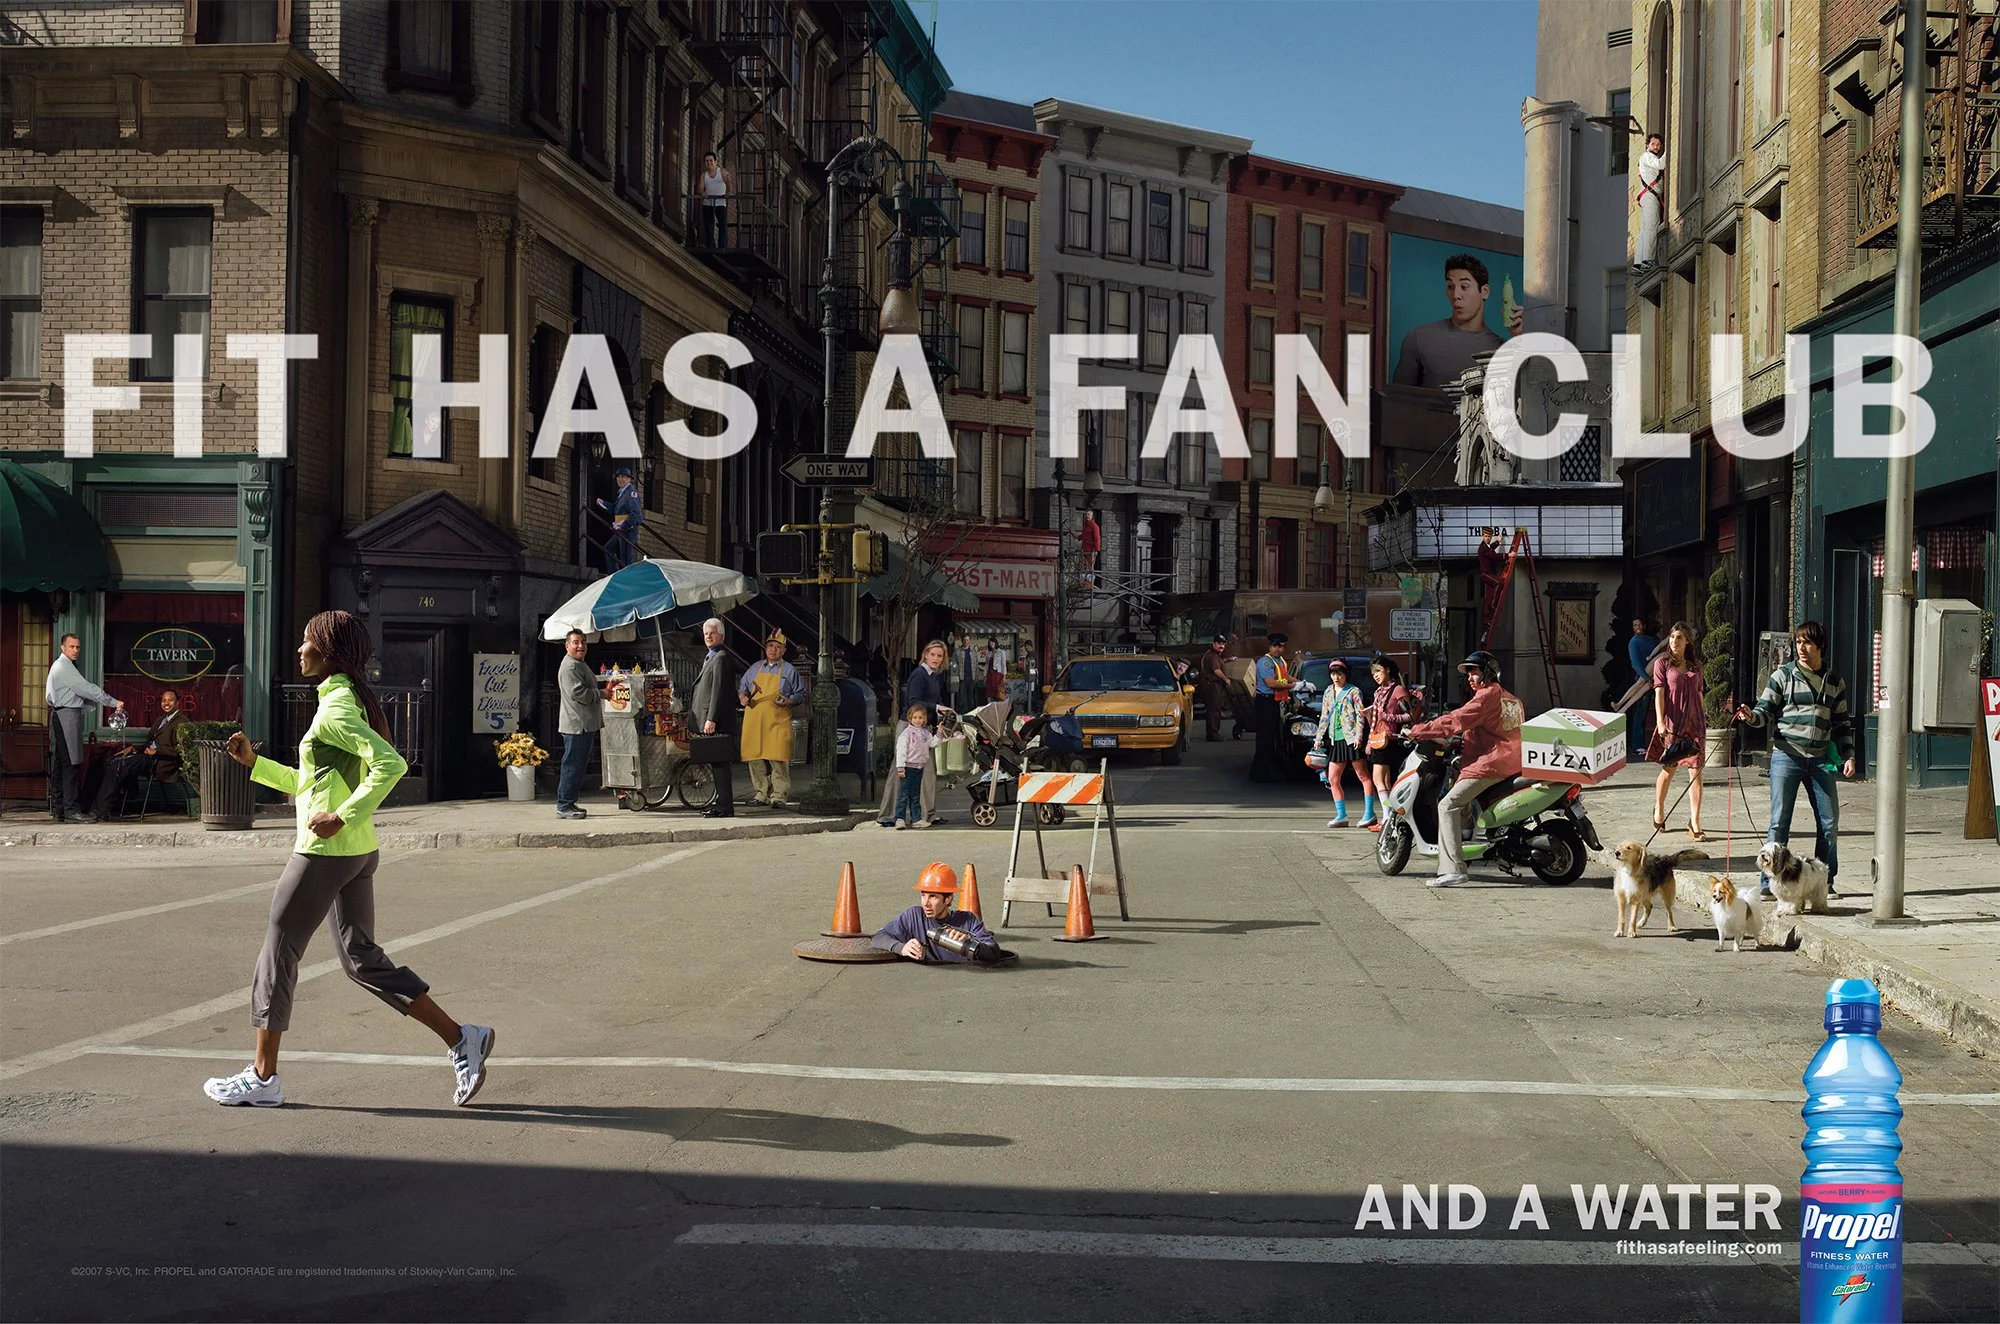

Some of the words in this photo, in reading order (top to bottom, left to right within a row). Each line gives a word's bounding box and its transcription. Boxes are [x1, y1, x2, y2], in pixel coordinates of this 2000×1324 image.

[807, 464, 833, 476] ONE
[838, 464, 865, 476] WAY
[419, 596, 435, 607] 740
[147, 649, 197, 660] TAVERN
[144, 694, 198, 712] PB
[1527, 750, 1591, 770] PIZZA
[1596, 740, 1625, 767] PIZZA
[1838, 1188, 1866, 1196] BERRY
[1802, 1204, 1901, 1248] Propel
[1811, 1251, 1851, 1260] FITNESS
[1855, 1251, 1889, 1260] WATER
[1833, 1281, 1870, 1295] Gatorade
